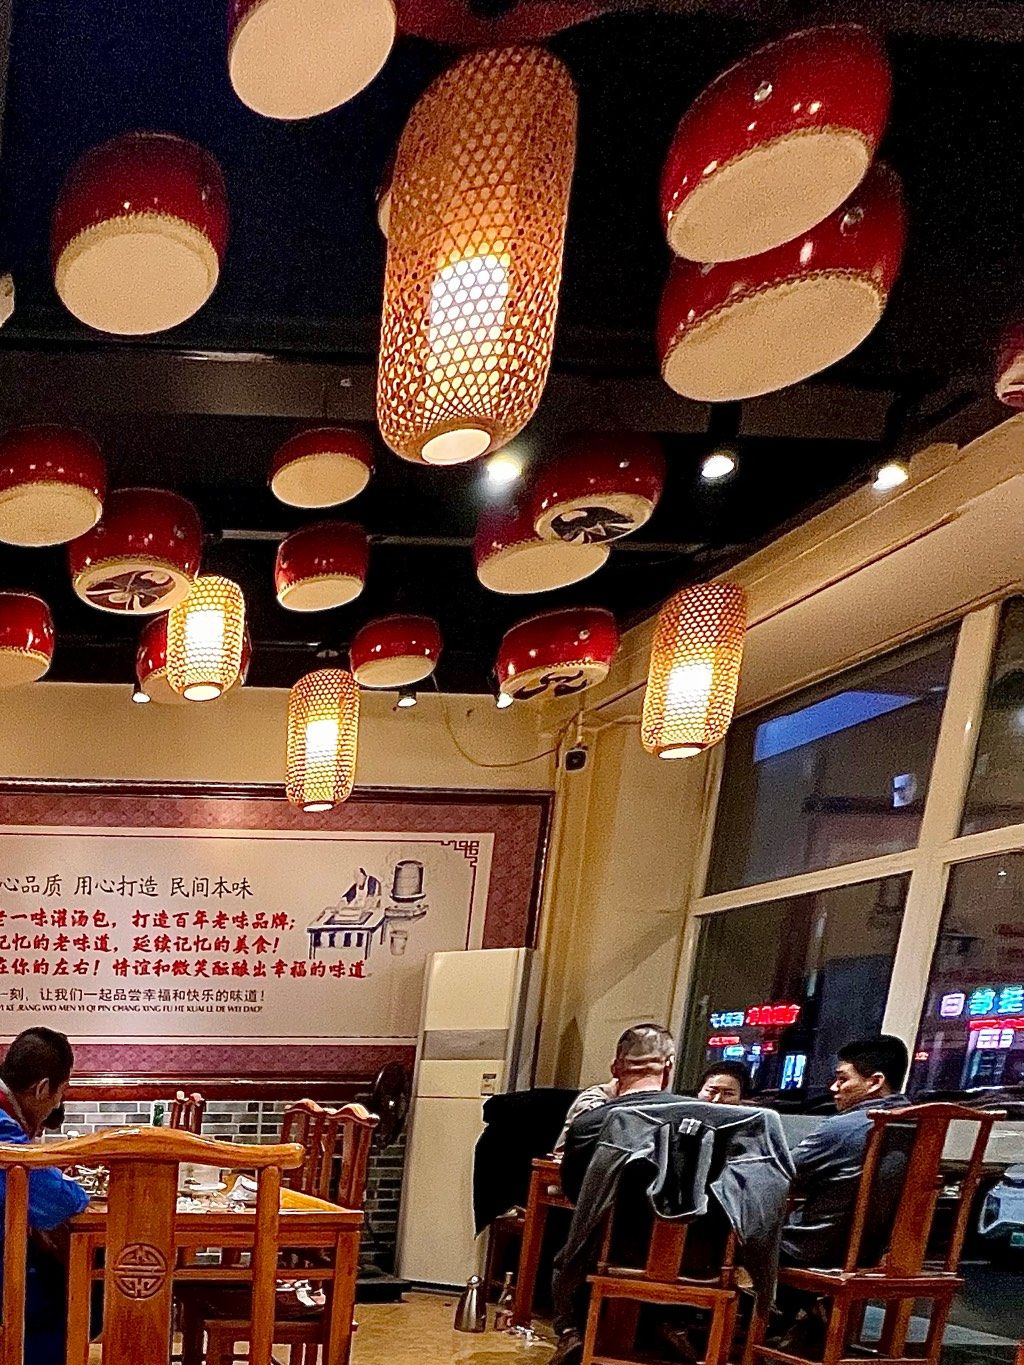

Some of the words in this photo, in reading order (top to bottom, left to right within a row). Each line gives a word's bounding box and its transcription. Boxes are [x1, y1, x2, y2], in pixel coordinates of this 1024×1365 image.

[74, 874, 159, 898] 用心打造
[170, 875, 254, 900] 民间本味
